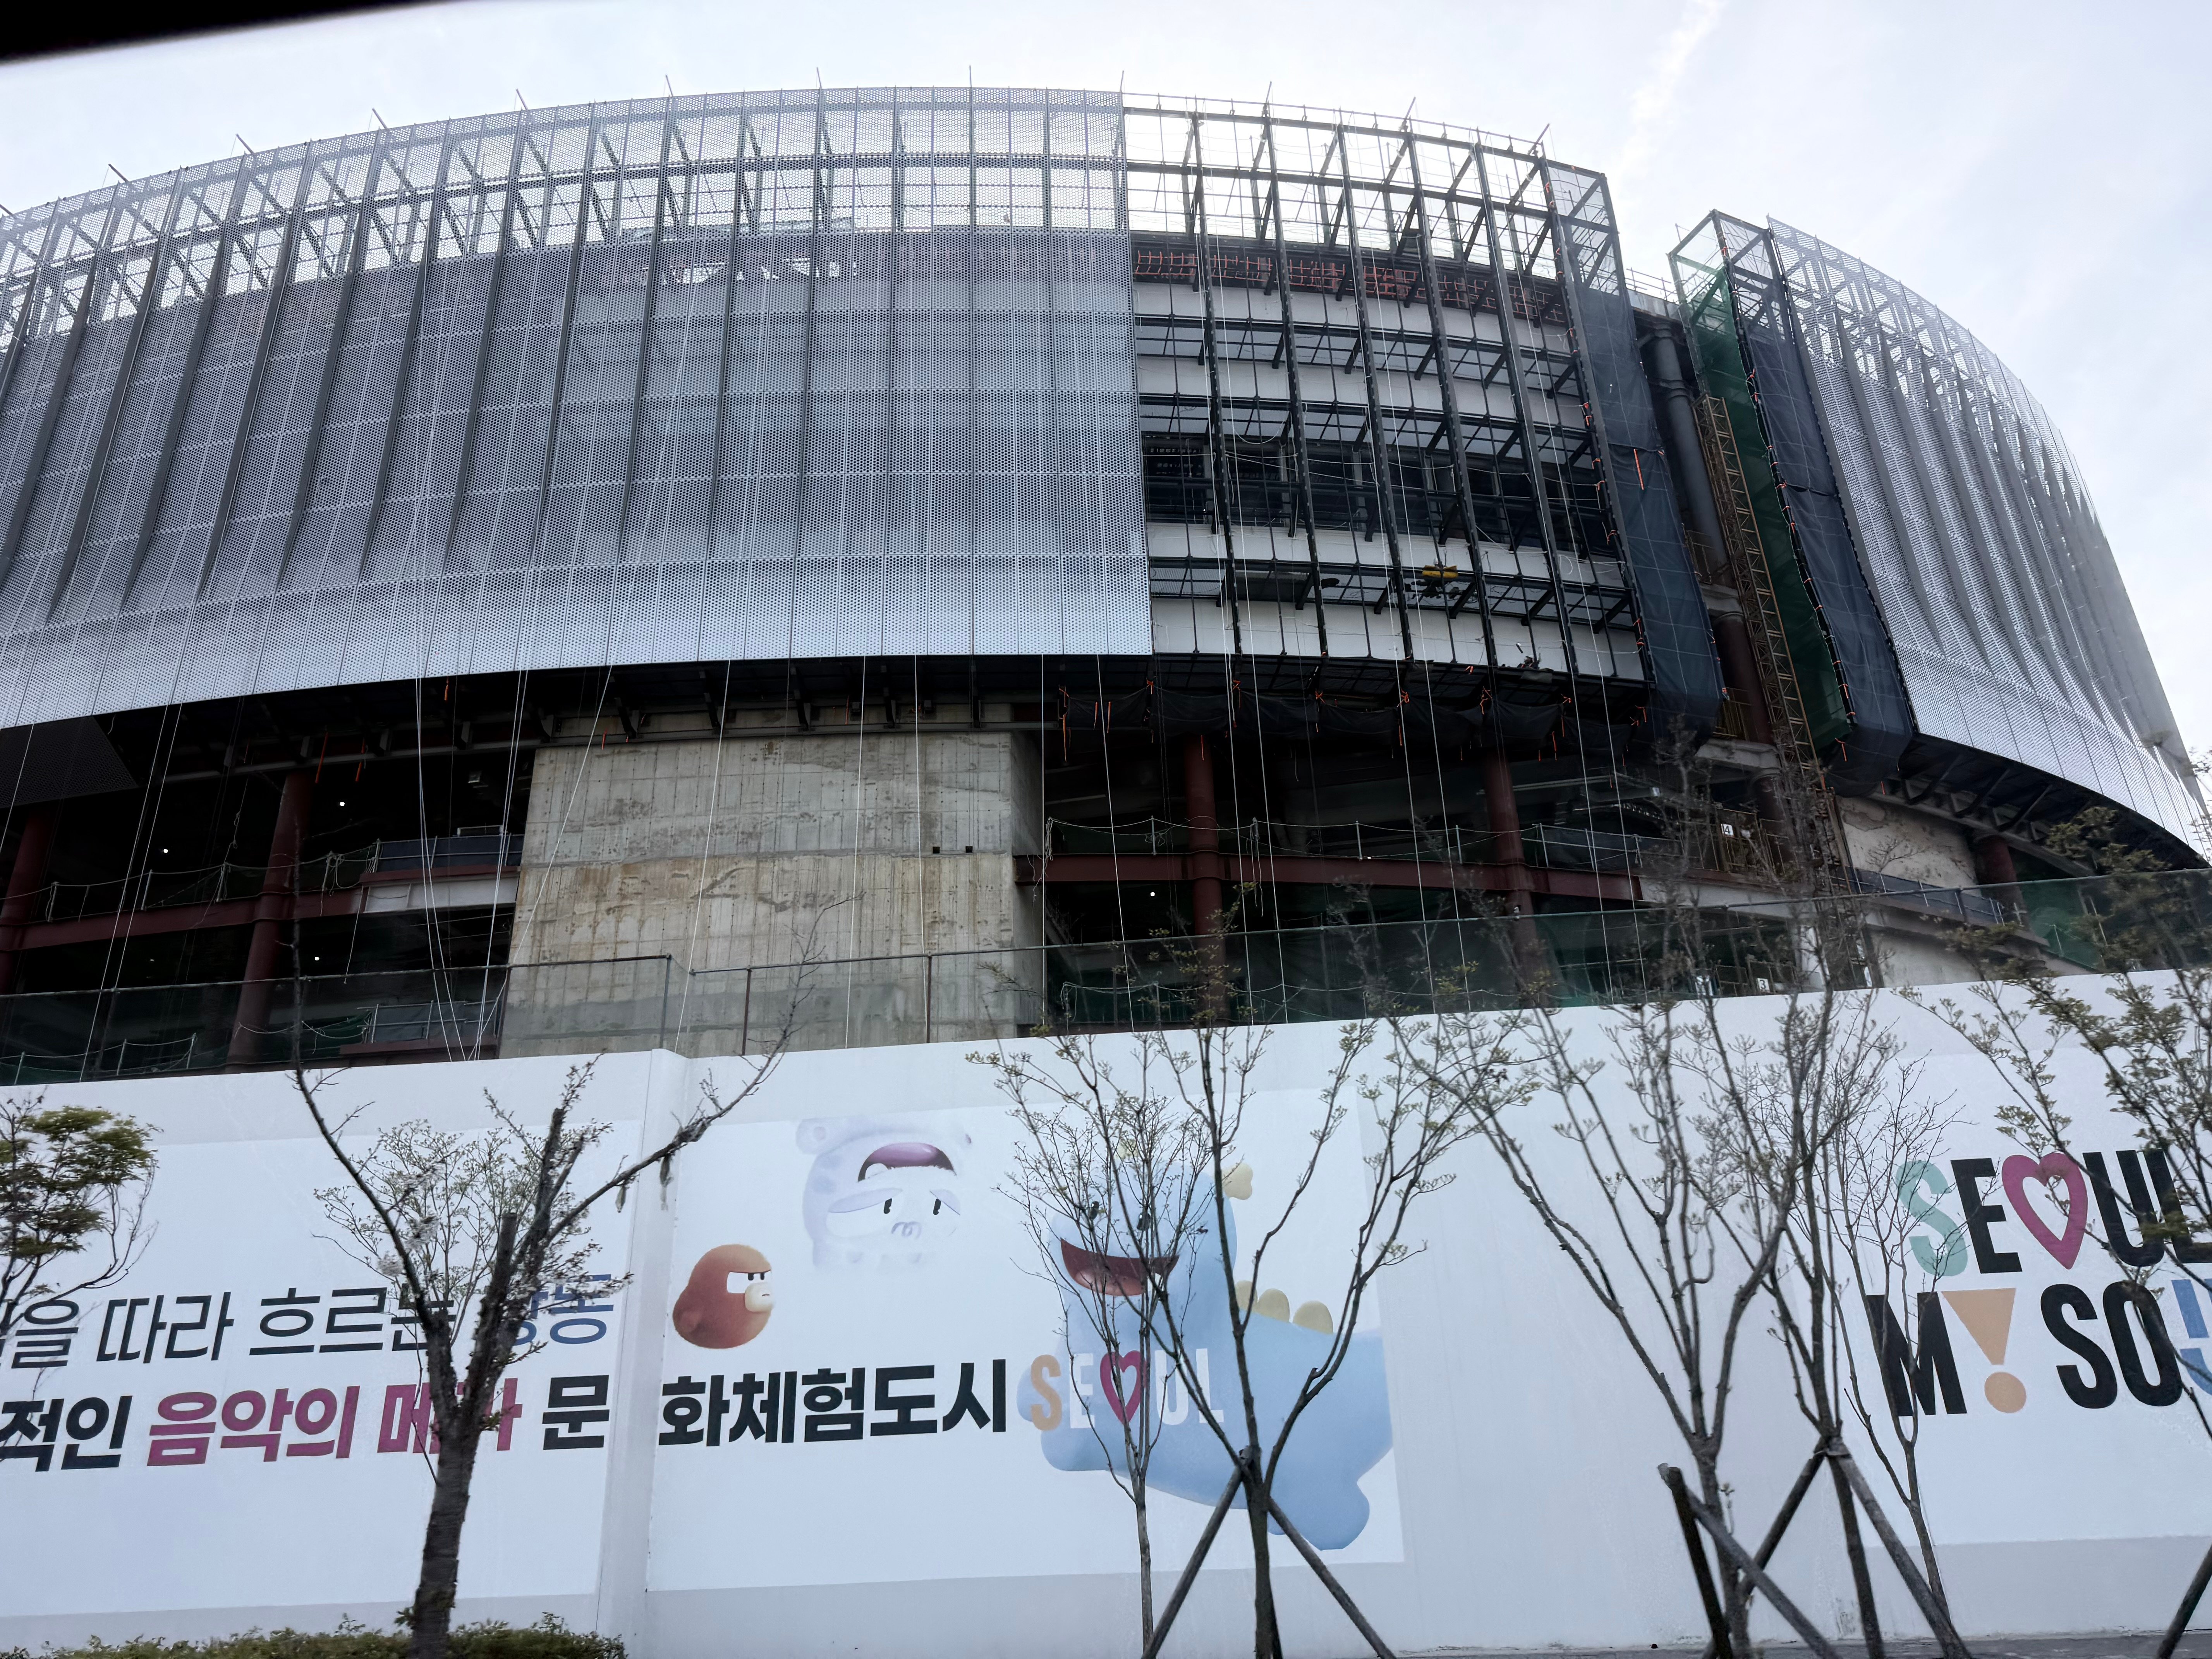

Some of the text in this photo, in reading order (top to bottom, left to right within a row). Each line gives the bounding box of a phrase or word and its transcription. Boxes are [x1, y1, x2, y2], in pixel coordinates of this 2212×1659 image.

[1760, 979, 1766, 989] 3
[0, 1300, 79, 1369] 을
[96, 1291, 234, 1364] 따라
[0, 1395, 133, 1472] 적인
[147, 1385, 360, 1467] 음악의
